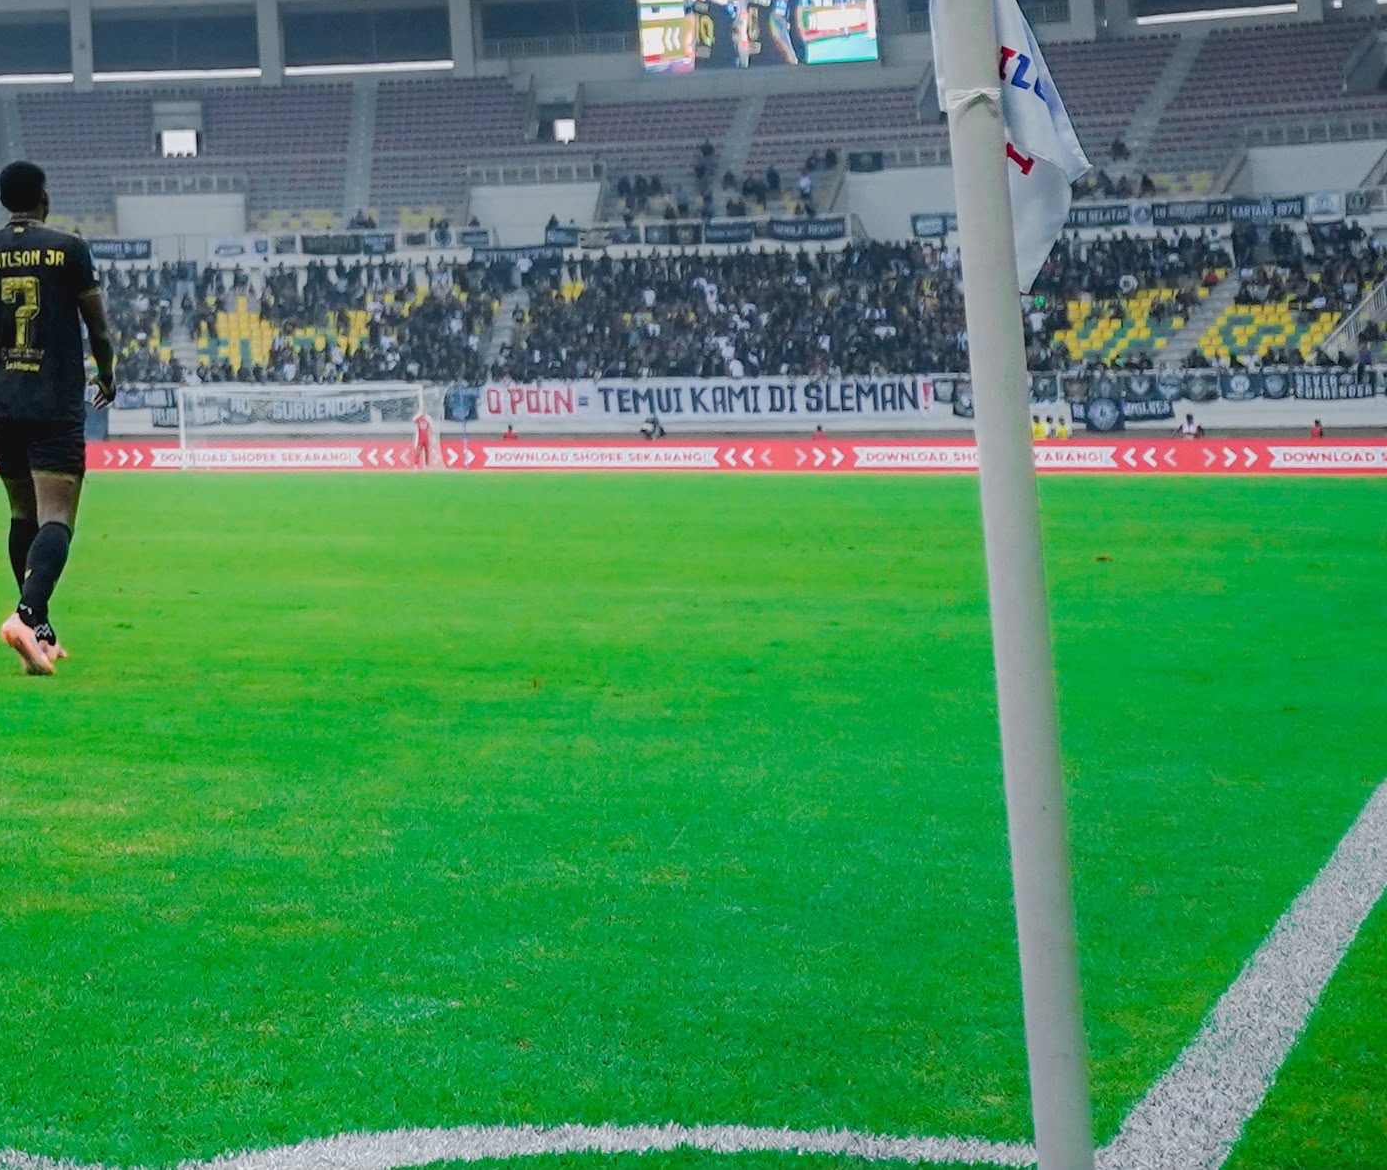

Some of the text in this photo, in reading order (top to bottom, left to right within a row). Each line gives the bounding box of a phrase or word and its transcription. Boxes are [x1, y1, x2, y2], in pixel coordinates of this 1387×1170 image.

[45, 249, 65, 266] JR
[1, 276, 40, 348] 7
[510, 388, 574, 415] POIN
[597, 385, 683, 414] TEMUI
[690, 385, 762, 413] KAMI
[768, 384, 797, 413] DI
[495, 451, 570, 463] DOWNLOAD
[866, 451, 948, 463] DOWNLOAD
[1283, 452, 1376, 463] DOWNLOAD
